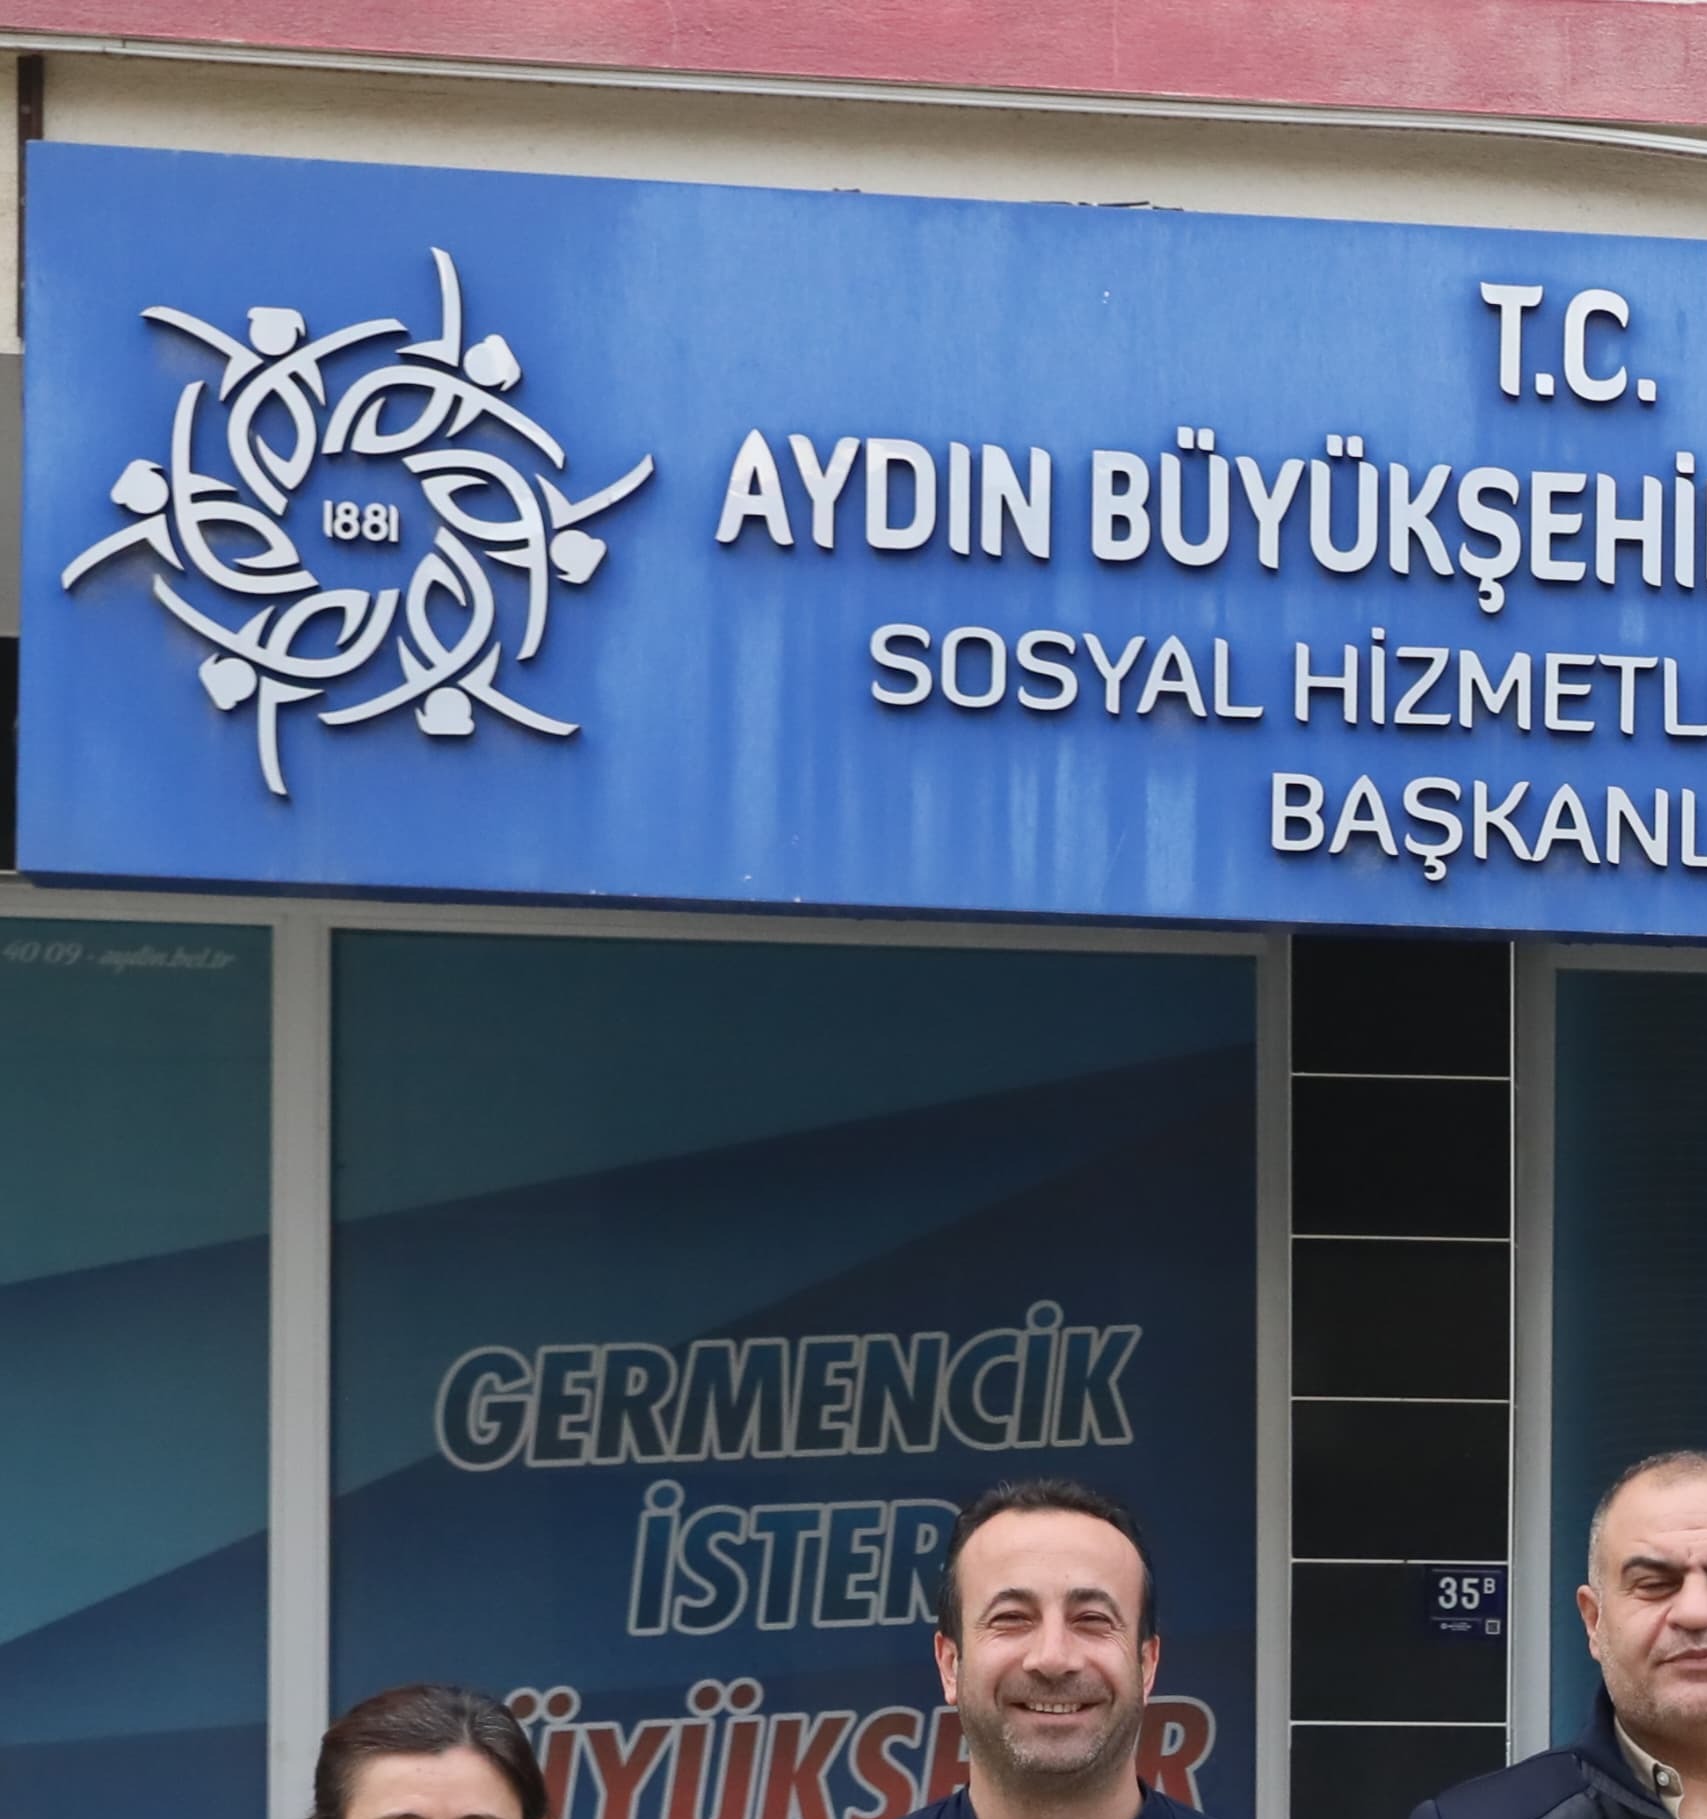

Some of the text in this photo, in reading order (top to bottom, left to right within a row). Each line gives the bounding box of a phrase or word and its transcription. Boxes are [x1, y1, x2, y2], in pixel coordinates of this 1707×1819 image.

[1480, 282, 1657, 402] T.C.
[322, 499, 400, 543] 1881
[716, 427, 1052, 560] AYDIN
[871, 623, 1263, 720] SOSYAL
[435, 1300, 1142, 1471] GERMENCİK
